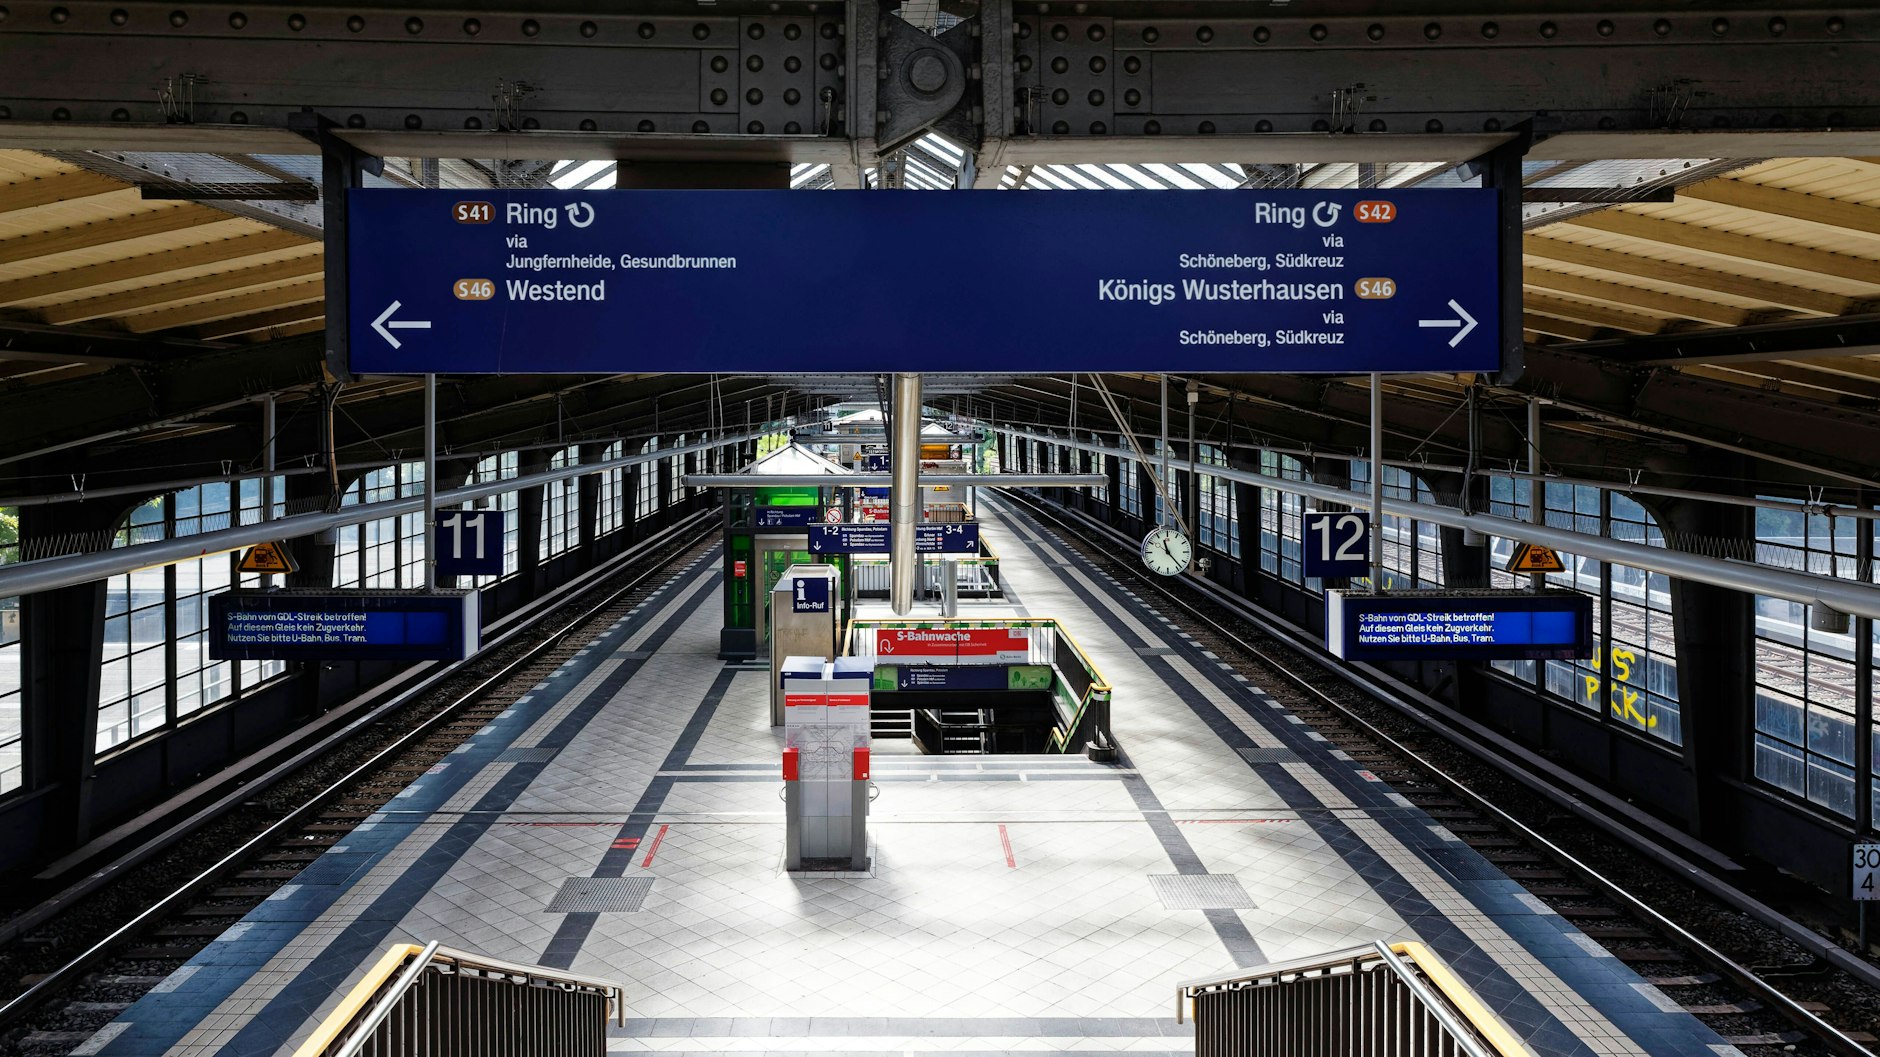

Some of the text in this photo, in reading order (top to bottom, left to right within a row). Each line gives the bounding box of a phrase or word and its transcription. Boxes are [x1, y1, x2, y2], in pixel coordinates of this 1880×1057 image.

[458, 202, 557, 230] S41 Ring
[1255, 202, 1391, 229] Ring S42
[506, 233, 528, 249] via
[1322, 233, 1344, 248] via
[506, 254, 737, 272] Jungfernheide, Gesundbrunnen
[1179, 253, 1344, 271] Schöneberg, Südkreuz
[458, 279, 605, 301] S46 Westend
[1099, 278, 1393, 305] Königs Wusterhausen S46
[1322, 310, 1344, 325] via
[1179, 330, 1344, 347] Schöneberg, Südkreuz
[823, 422, 831, 431] 11
[944, 422, 953, 430] 12
[879, 455, 889, 466] 1-
[442, 513, 486, 559] 11
[822, 526, 839, 536] 1-2
[945, 524, 963, 535] 3-4
[1311, 514, 1365, 561] 12
[796, 602, 825, 610] Info-Ruf
[227, 612, 257, 621] S-Bahn
[277, 612, 323, 621] GDL-Streik
[324, 612, 367, 621] betroffen!
[1358, 613, 1388, 622] S-Bahn
[1407, 613, 1452, 622] GDL-Streik
[1453, 613, 1495, 622] betroffen!
[228, 623, 367, 633] Auf diesem Gleis kein Zugverkehr.
[1359, 624, 1495, 634] Auf diesem Gleis kein Zugverkehr.
[227, 634, 256, 642] Nutzen
[257, 634, 270, 642] Sie
[271, 634, 291, 642] bitte
[292, 634, 324, 643] U-Bahn,
[343, 634, 368, 642] Tram.
[896, 631, 971, 642] S-Bahnwache
[1358, 634, 1496, 644] Nutzen Sie bitte U-Bahn, Bus, Tram.
[1854, 848, 1880, 869] 30
[1860, 871, 1875, 893] 4
